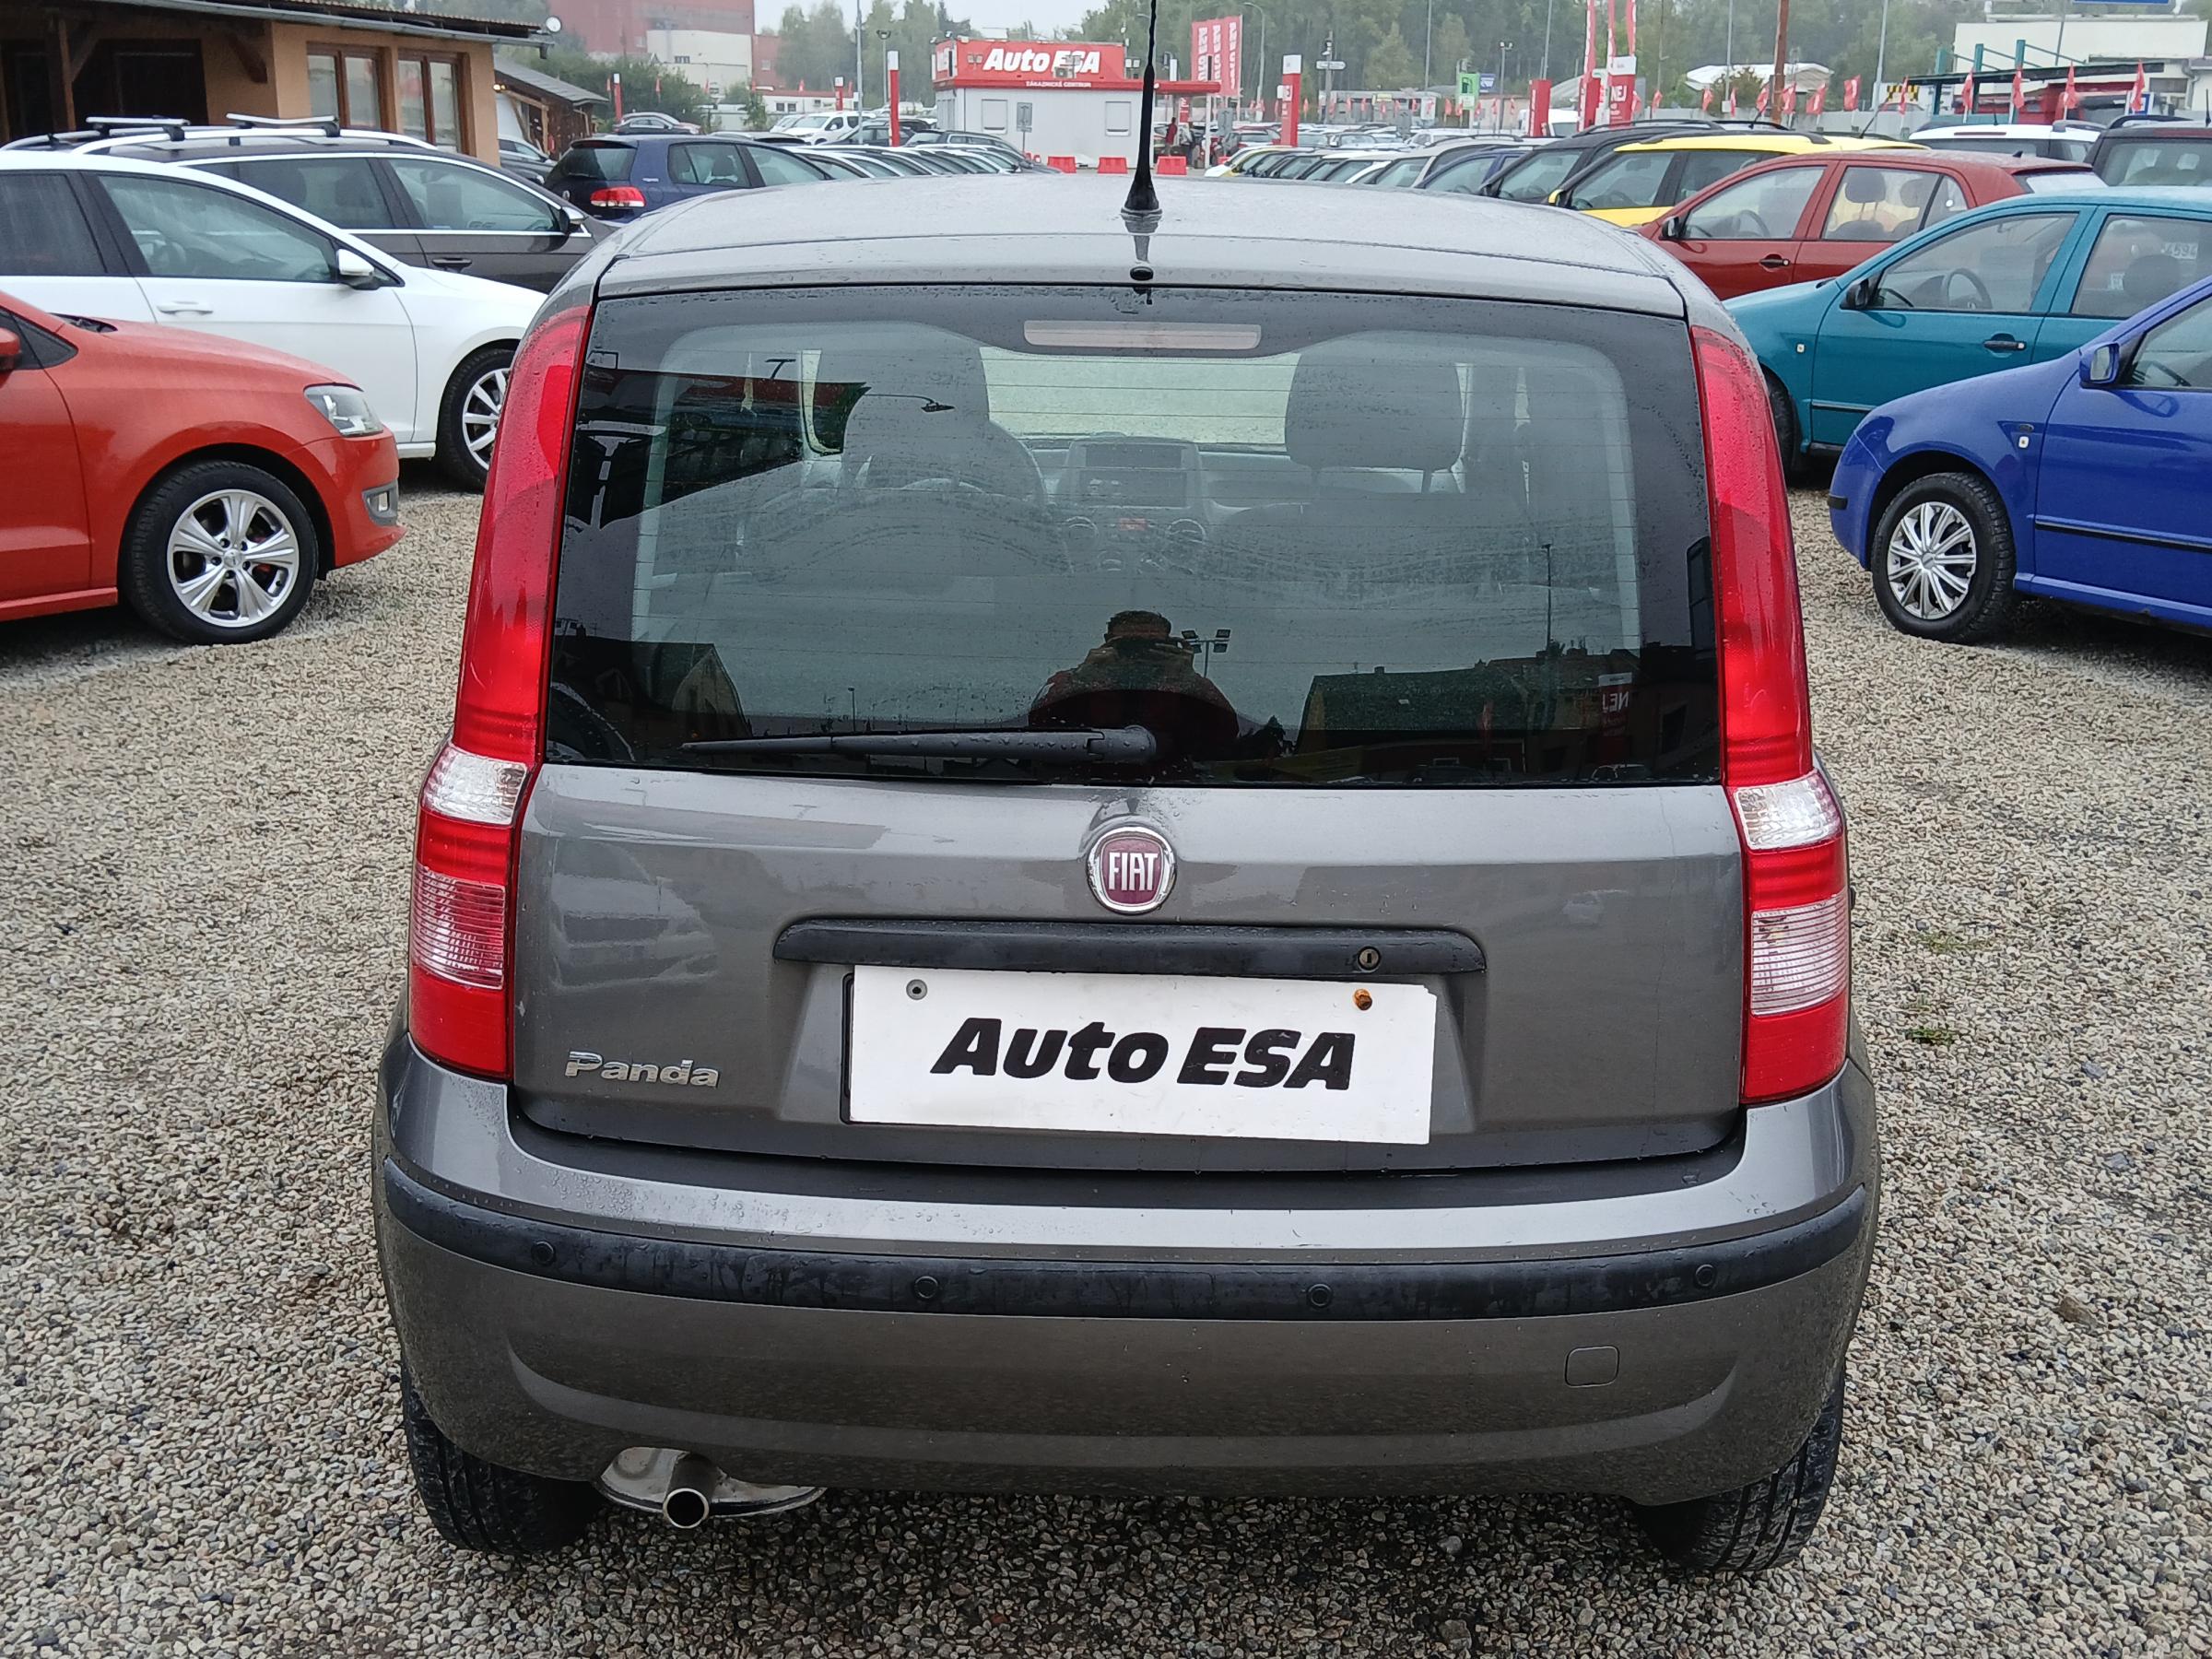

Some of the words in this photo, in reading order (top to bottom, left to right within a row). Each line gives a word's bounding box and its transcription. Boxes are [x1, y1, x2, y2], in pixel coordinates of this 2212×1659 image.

[982, 48, 1050, 72] Auto
[1109, 852, 1159, 890] FIAT
[565, 1051, 719, 1088] Panda
[930, 1018, 1169, 1084] Auto
[1177, 1027, 1356, 1090] ESA
